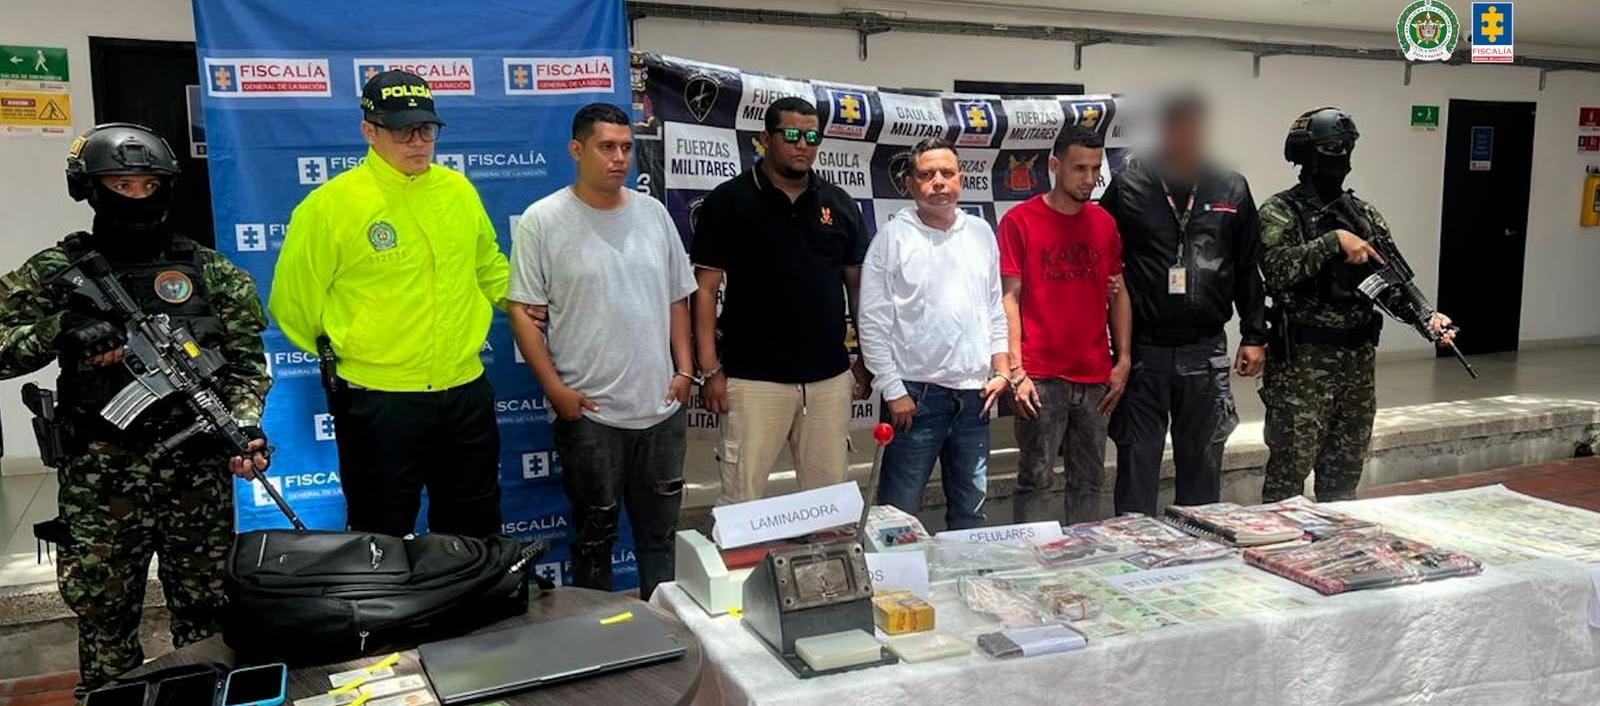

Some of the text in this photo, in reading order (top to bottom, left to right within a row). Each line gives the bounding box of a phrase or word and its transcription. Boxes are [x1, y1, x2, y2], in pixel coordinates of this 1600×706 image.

[240, 62, 326, 78] FISCALÍA
[536, 59, 610, 76] FISCALÍA
[381, 85, 432, 100] POLICÍA
[896, 107, 937, 122] GAULA
[1015, 112, 1058, 126] FUERZAS
[890, 122, 943, 137] MILITAR
[1008, 127, 1058, 140] MILITARES
[676, 138, 730, 158] FUERZAS
[468, 150, 547, 166] FISCALÍA
[818, 151, 860, 168] GAULA
[671, 158, 737, 178] MILITARES
[750, 503, 840, 531] LAMINADORA
